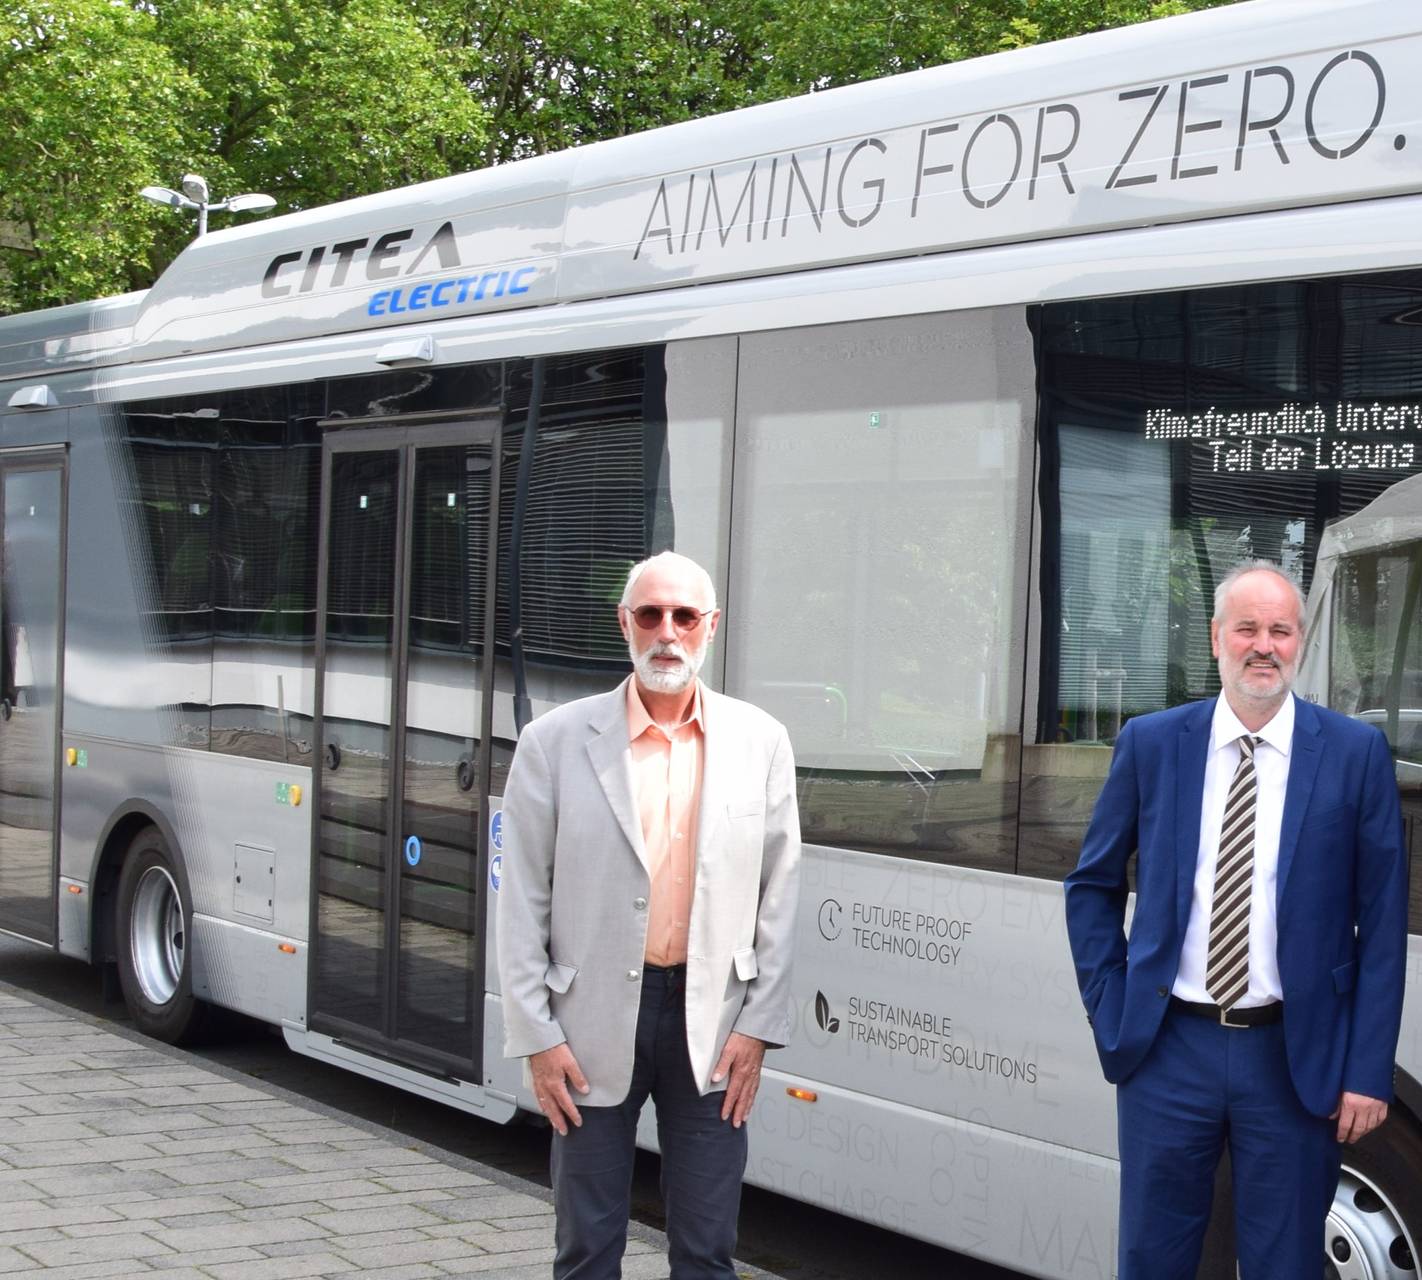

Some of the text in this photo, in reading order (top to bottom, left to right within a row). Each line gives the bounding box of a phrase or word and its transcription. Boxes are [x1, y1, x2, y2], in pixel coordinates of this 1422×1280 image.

[634, 49, 1407, 261] AIMING FOR ZERO.
[367, 266, 537, 317] ELECTRIC
[1145, 401, 1326, 439] Klimafreundlich
[1208, 436, 1415, 471] Teil der Lösung
[852, 902, 973, 942] FUTURE PROOF
[852, 926, 962, 966] TECHNOLOGY
[848, 995, 952, 1038] SUSTAINABLE
[848, 1020, 940, 1060] TRANSPORT
[941, 1043, 1038, 1084] SOLUTIONS
